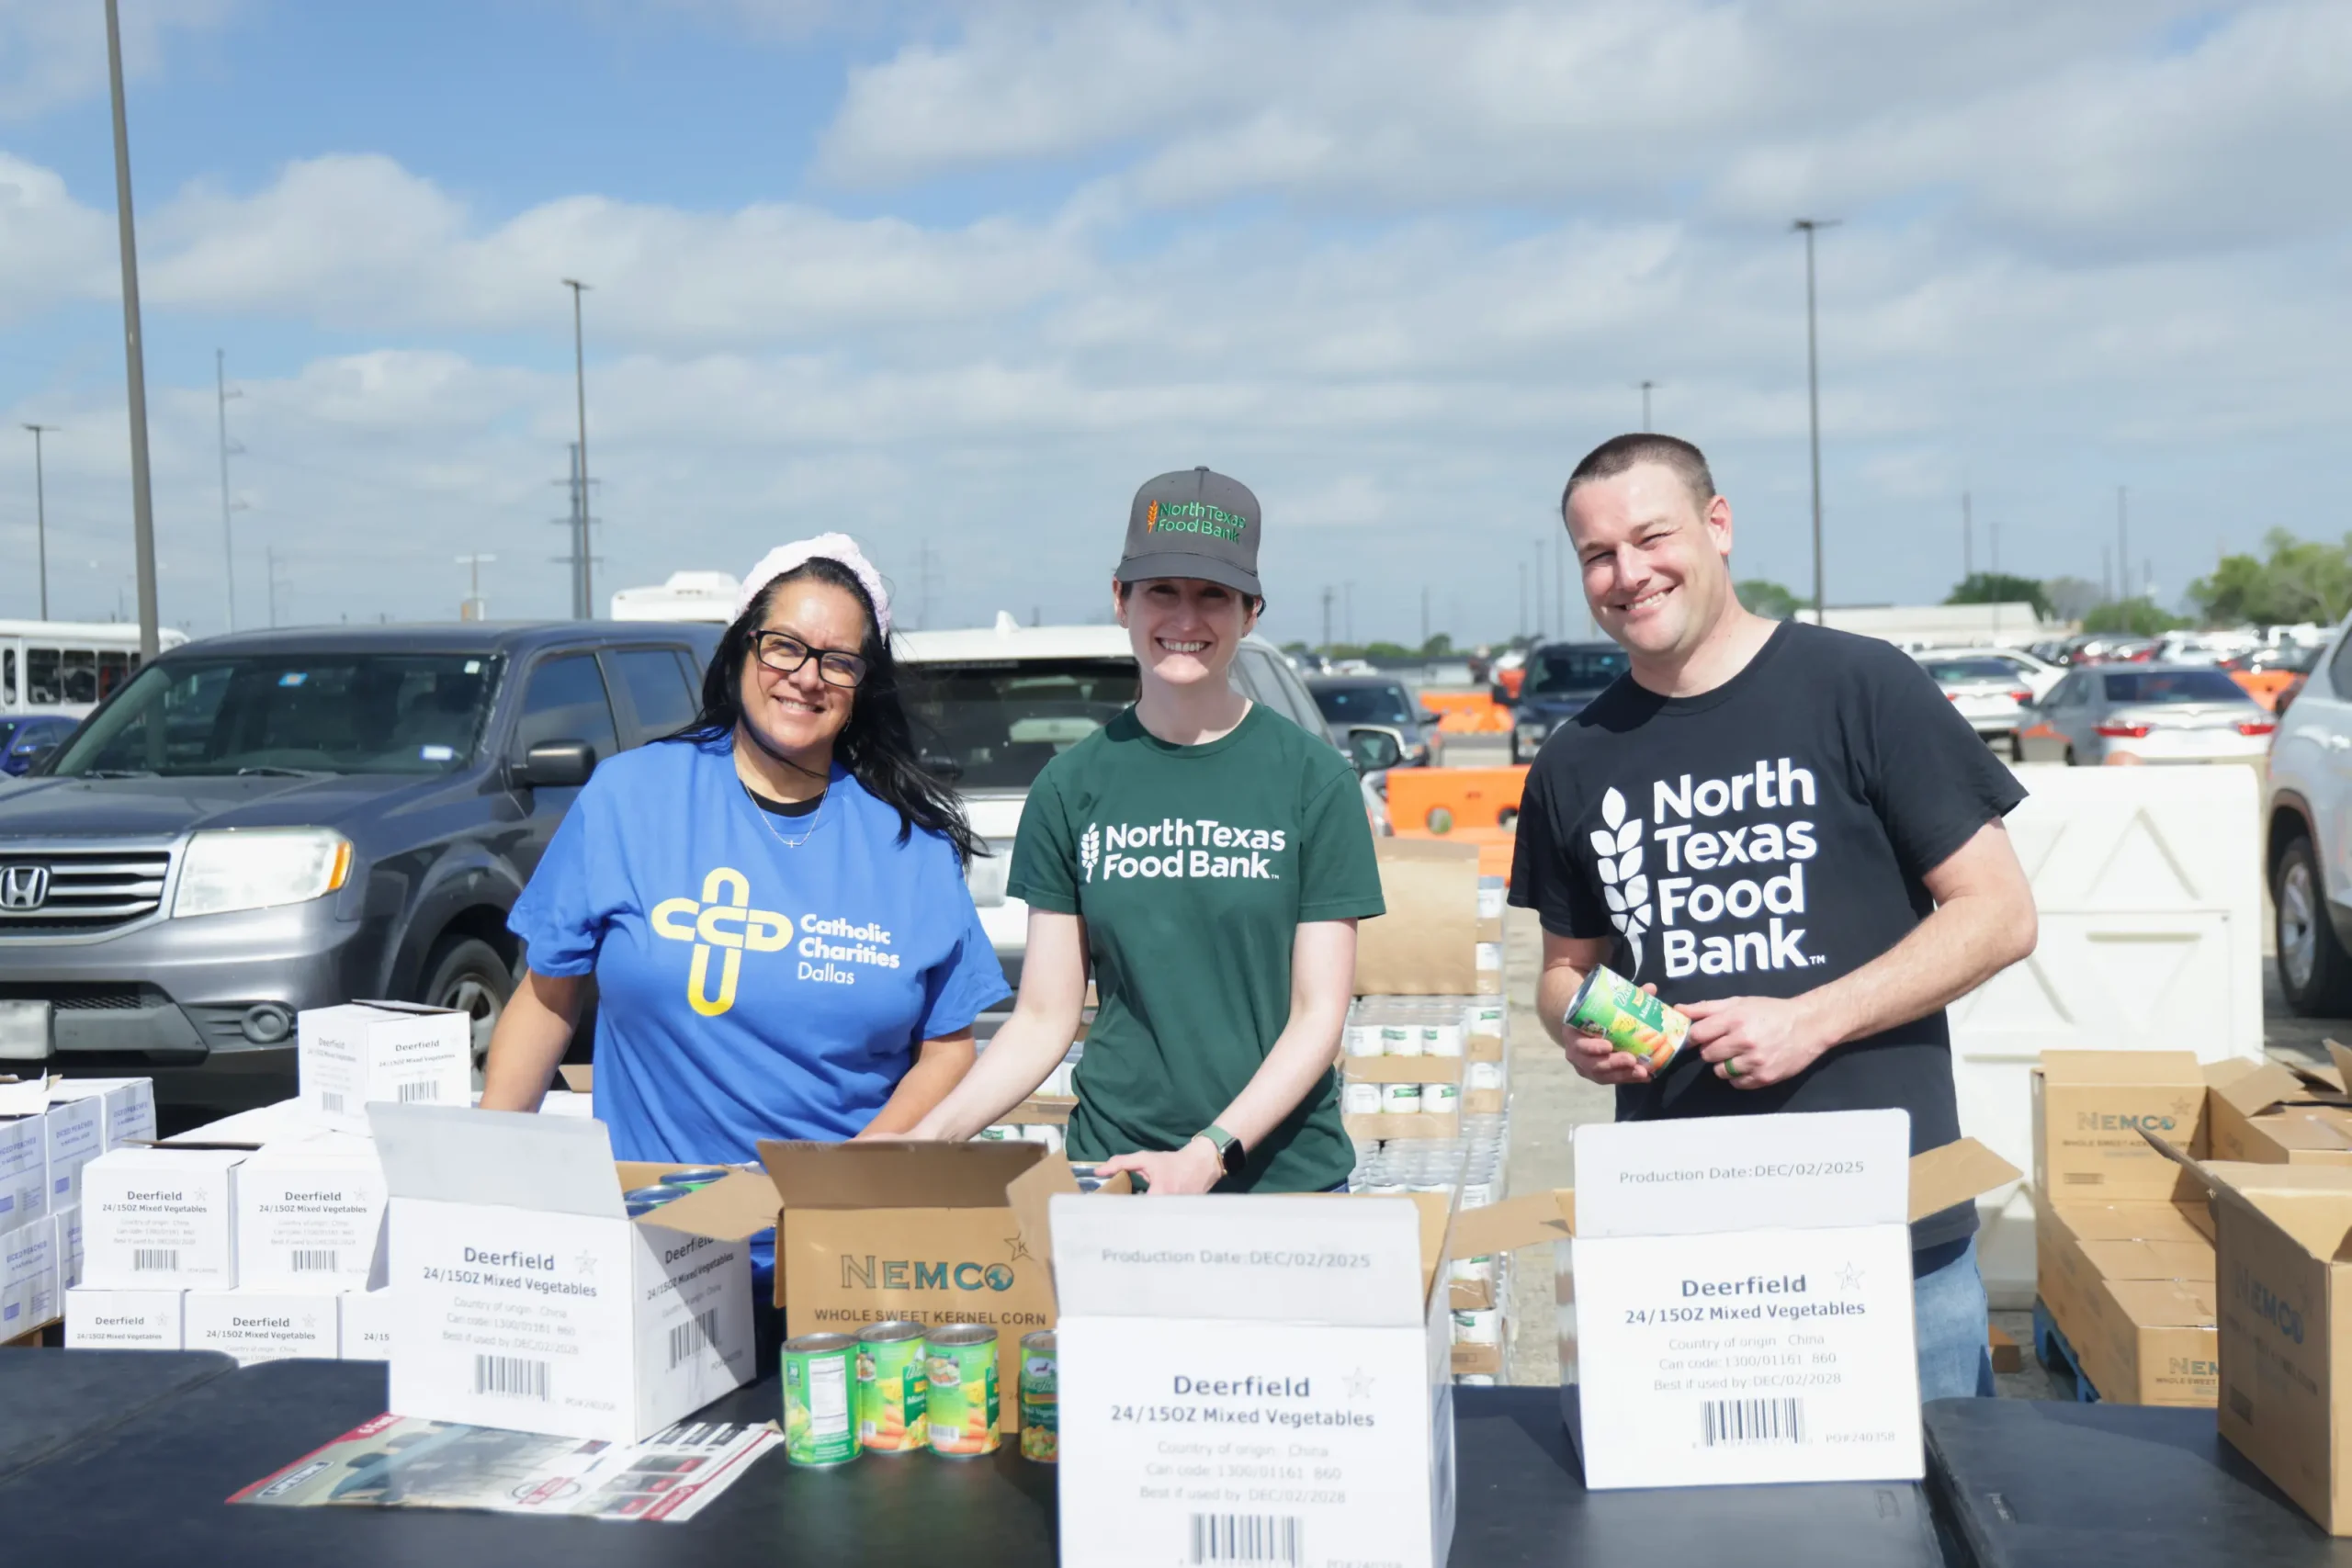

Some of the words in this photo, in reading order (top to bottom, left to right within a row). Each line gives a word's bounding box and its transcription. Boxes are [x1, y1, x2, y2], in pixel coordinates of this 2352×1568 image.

[1159, 502, 1204, 517] North
[1206, 504, 1246, 529] Texas
[1156, 519, 1199, 534] Food
[1201, 521, 1240, 545] Bank
[1654, 758, 1816, 825] North
[1105, 818, 1194, 852] North
[1195, 819, 1286, 852] Texas
[1654, 820, 1818, 873] Texas
[1102, 849, 1183, 881] Food
[1189, 850, 1272, 879] Bank
[1657, 862, 1804, 926] Food
[799, 913, 891, 945] Catholic
[797, 937, 900, 969] Charities
[1663, 918, 1809, 978] Bank
[797, 961, 855, 985] Dallas
[395, 1039, 441, 1053] Deerfield
[2076, 1111, 2177, 1131] NEMCO
[1619, 1168, 1704, 1184] Production
[127, 1190, 183, 1201] Deerfield
[285, 1190, 343, 1201] Deerfield
[139, 1204, 164, 1213] Mixed
[164, 1204, 209, 1215] Vegetables
[297, 1204, 322, 1213] Mixed
[322, 1204, 368, 1215] Vegetables
[463, 1246, 556, 1272] Deerfield
[1102, 1248, 1194, 1266] Production
[840, 1254, 1015, 1292] NEMCO
[483, 1271, 522, 1290] Mixed
[525, 1277, 598, 1298] Vegetables
[1681, 1274, 1807, 1298] Deerfield
[95, 1316, 145, 1326] Deerfield
[815, 1309, 871, 1323] WHOLE
[875, 1310, 929, 1324] SWEET
[933, 1311, 999, 1325] KERNEL
[1001, 1312, 1046, 1325] CORN
[1709, 1305, 1761, 1322] Mixed
[1766, 1301, 1866, 1322] Vegetables
[232, 1316, 290, 1328] Deerfield
[244, 1330, 269, 1340] Mixed
[271, 1331, 316, 1342] Vegetables
[364, 1332, 390, 1342] 24/15
[1668, 1337, 1720, 1351] Country
[1724, 1337, 1736, 1349] of
[1788, 1333, 1825, 1347] China
[1658, 1359, 1684, 1371] Can
[1812, 1352, 1837, 1364] 860
[1173, 1374, 1310, 1398] Deerfield
[1653, 1380, 1681, 1391] Best
[1697, 1377, 1728, 1390] used
[1203, 1406, 1260, 1425] Mixed
[1266, 1408, 1375, 1429] Vegetables
[1157, 1440, 1212, 1457] Country
[1217, 1441, 1231, 1455] of
[1288, 1443, 1329, 1458] China
[1145, 1462, 1173, 1476] Can
[1139, 1486, 1170, 1500] Best
[1186, 1487, 1220, 1502] used
